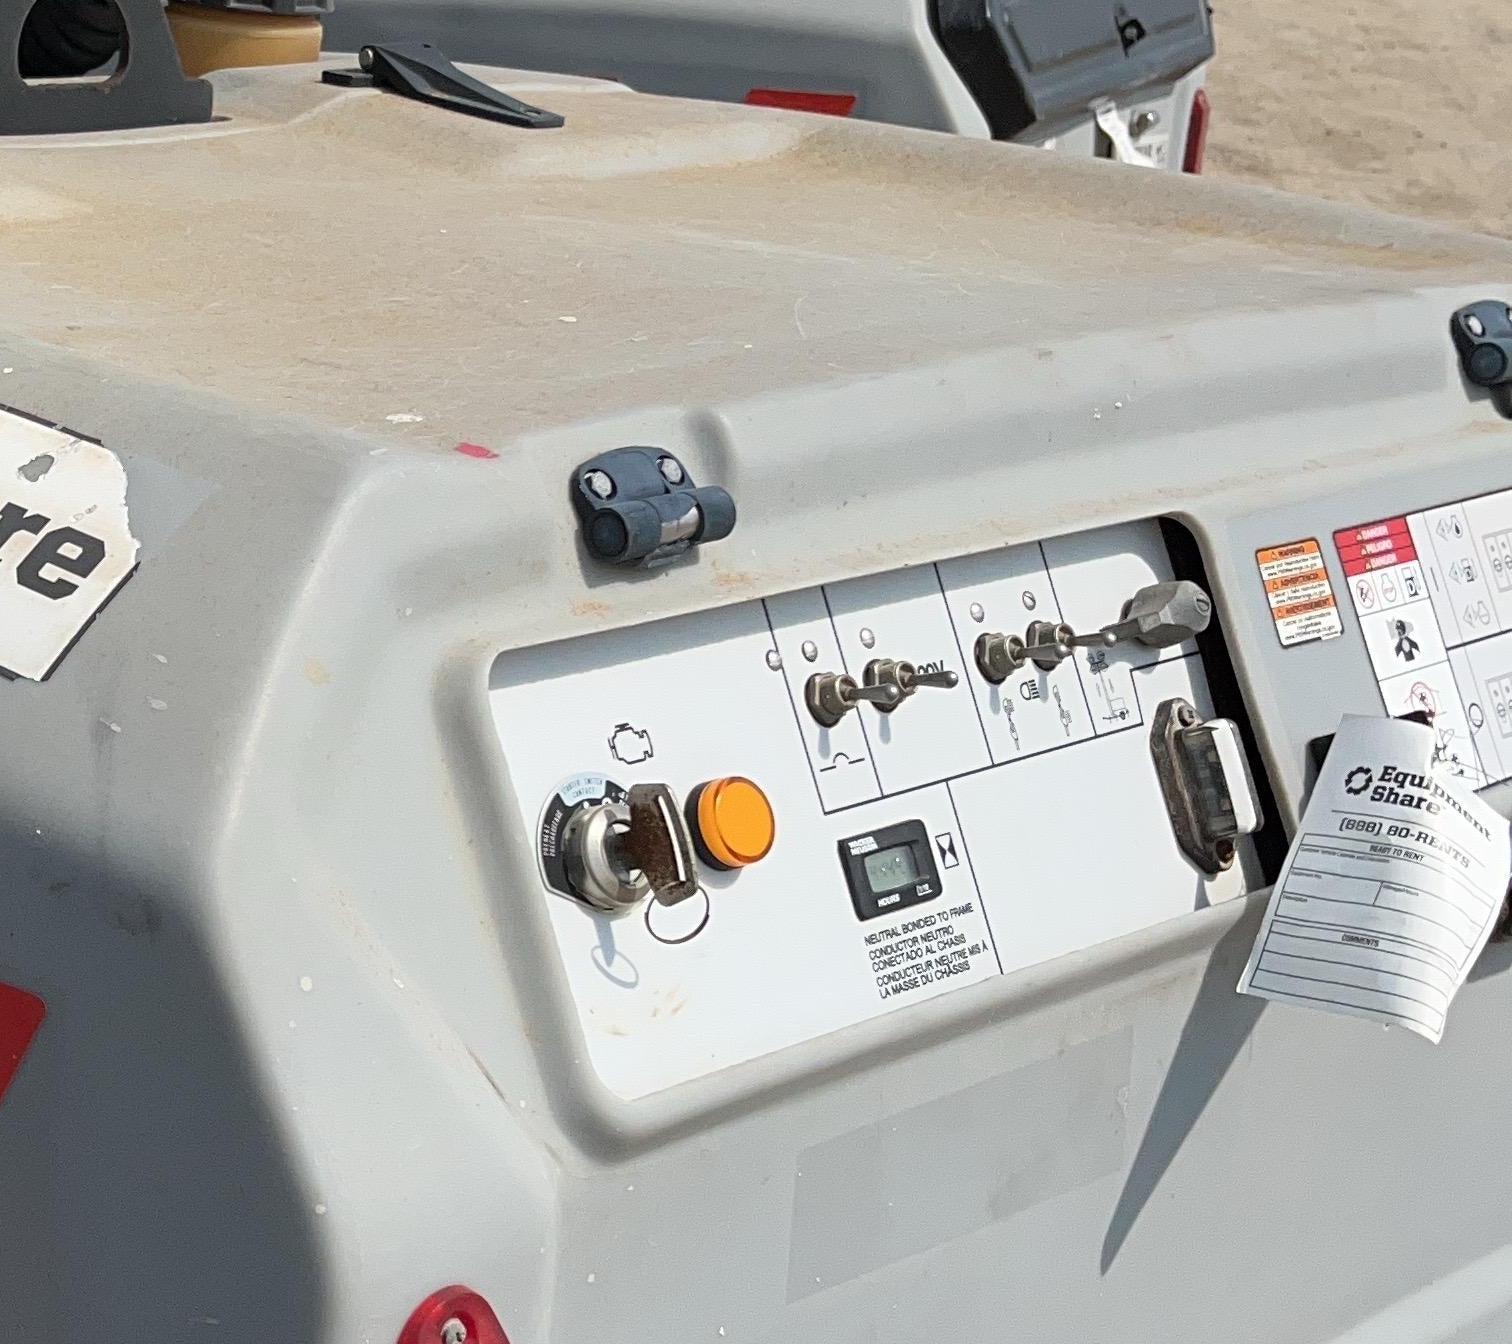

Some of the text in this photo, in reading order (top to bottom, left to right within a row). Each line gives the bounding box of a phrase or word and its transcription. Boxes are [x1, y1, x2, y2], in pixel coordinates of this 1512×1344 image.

[1370, 785, 1441, 816] Share
[1377, 765, 1493, 842] Equipment
[1338, 817, 1383, 836] (888)
[1386, 824, 1472, 869] 80-RENTS
[1369, 844, 1391, 856] READY
[1392, 849, 1403, 857] TO
[1403, 850, 1425, 863] RENT
[864, 902, 975, 947] NEUTRAL BONDED TO FRAME
[868, 924, 955, 961] CONDUCTOR NEUTRO
[1341, 933, 1380, 948] COMMENTS
[872, 933, 967, 973] CONECTADO AL CHASIS
[876, 959, 935, 988] CONDUCTEUR
[934, 948, 969, 969] NEUTRE
[879, 985, 891, 999] LA
[891, 975, 921, 996] MASSE
[920, 971, 934, 987] DU
